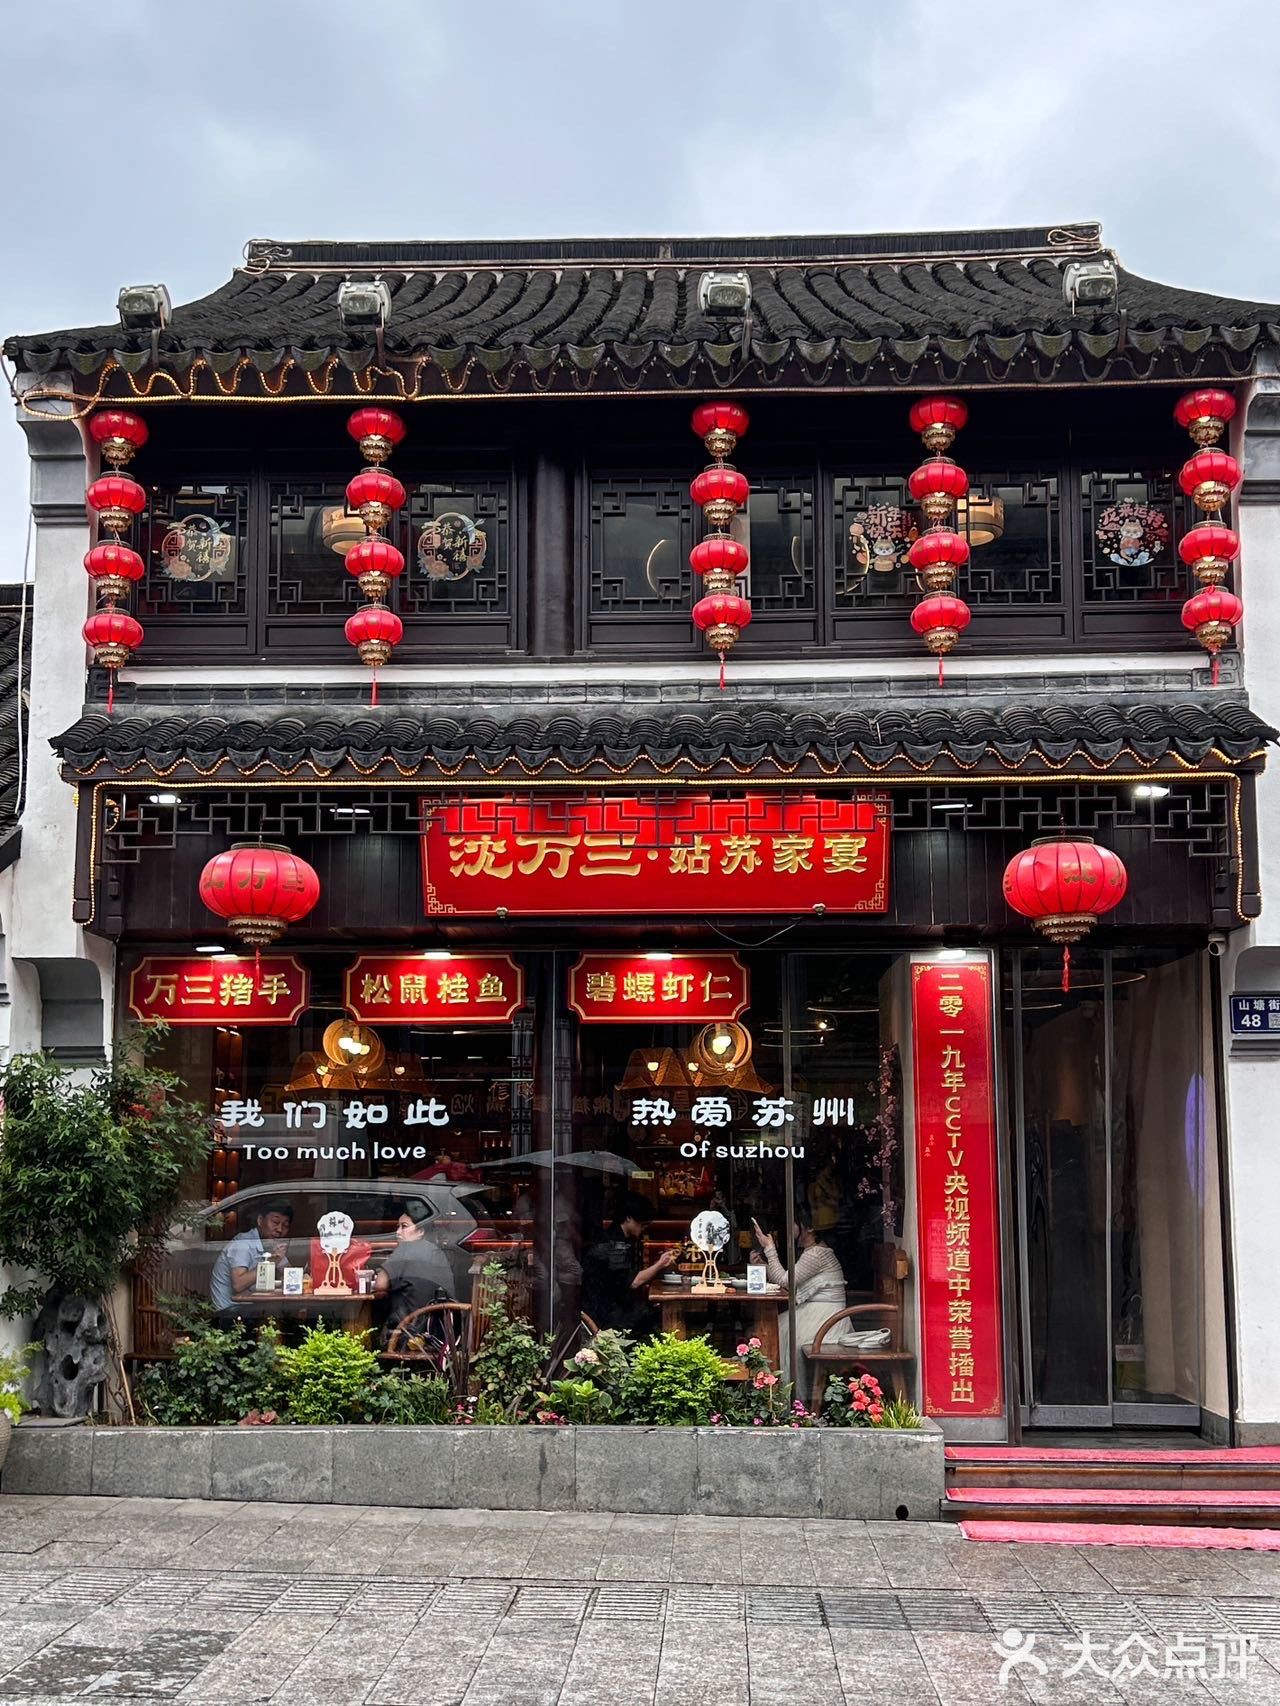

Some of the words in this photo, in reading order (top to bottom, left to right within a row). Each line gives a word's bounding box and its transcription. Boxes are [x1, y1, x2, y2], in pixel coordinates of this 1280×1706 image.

[144, 972, 291, 1006] 万三猪手
[360, 972, 507, 1005] 松鼠桂鱼
[586, 971, 733, 1003] 碧螺虾仁
[1239, 999, 1280, 1011] 山塘街
[1241, 1014, 1261, 1027] 48
[220, 1098, 450, 1129] 我们如此
[631, 1097, 854, 1127] 热爱苏州
[243, 1144, 289, 1160] Too
[297, 1142, 365, 1160] much
[373, 1142, 426, 1160] love
[680, 1141, 710, 1158] Of
[716, 1141, 805, 1159] suzhou
